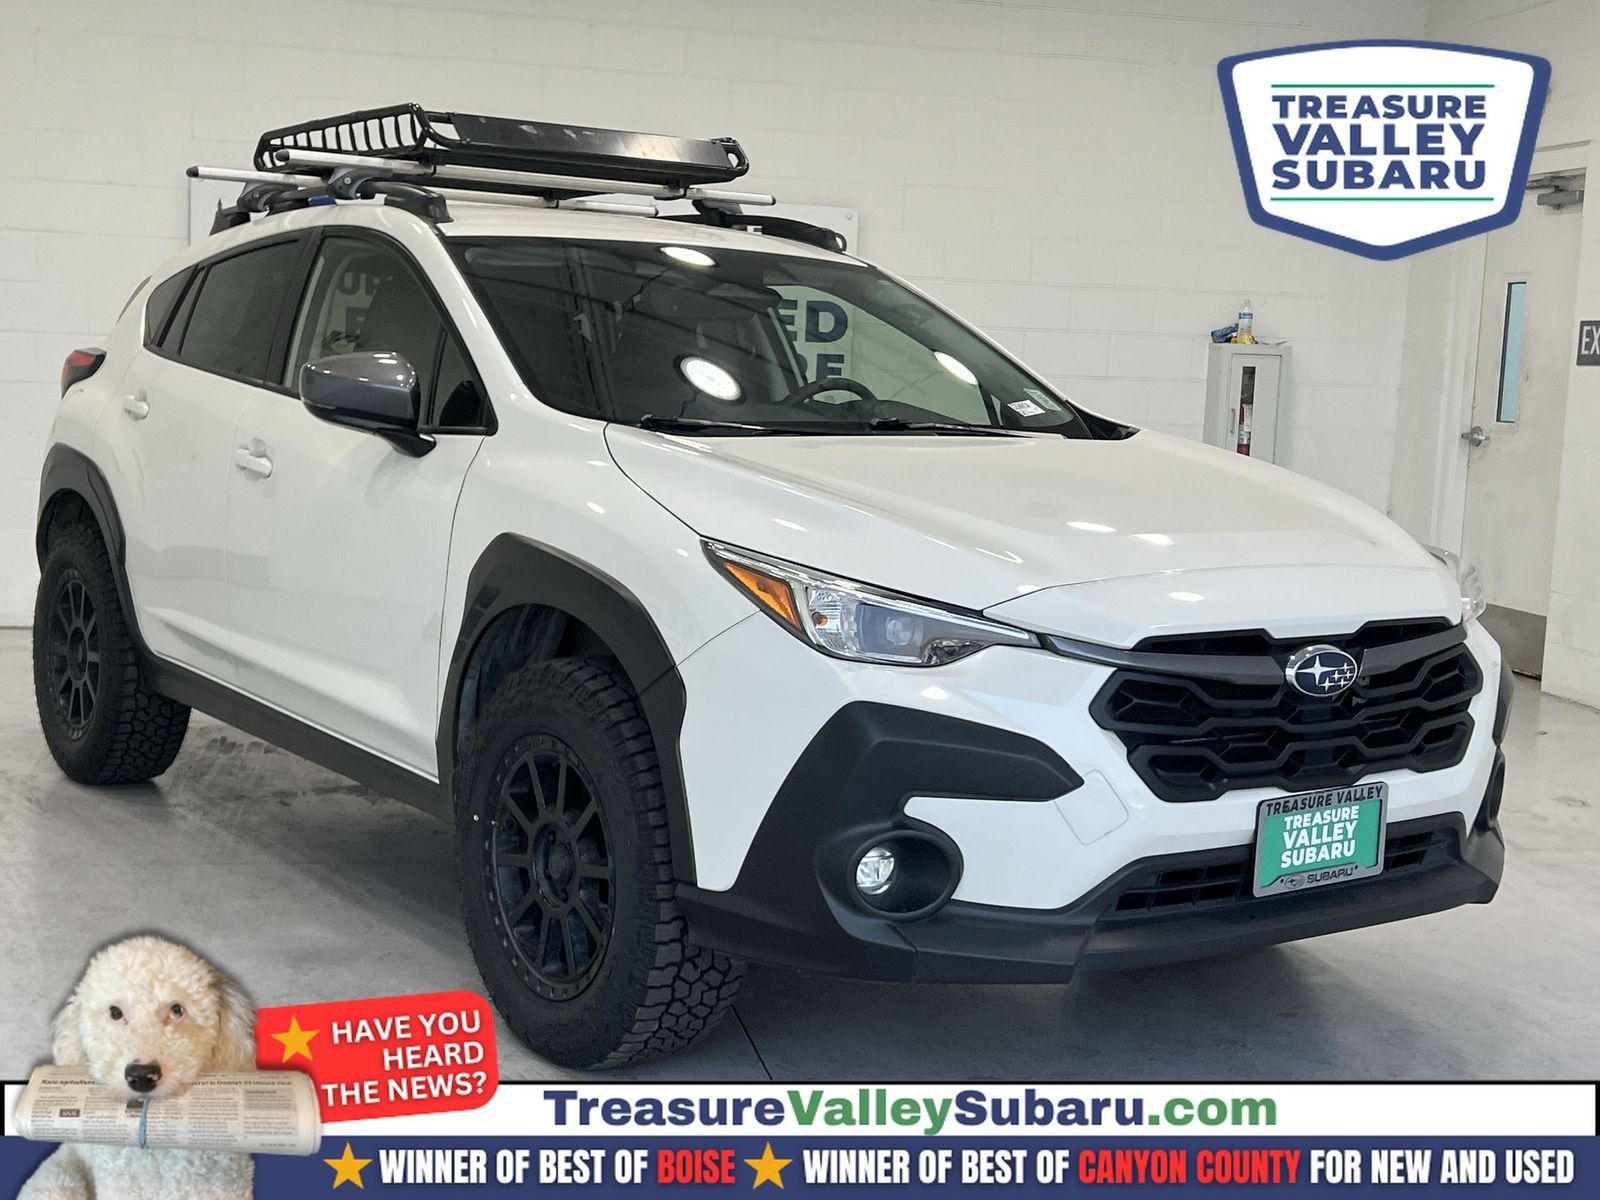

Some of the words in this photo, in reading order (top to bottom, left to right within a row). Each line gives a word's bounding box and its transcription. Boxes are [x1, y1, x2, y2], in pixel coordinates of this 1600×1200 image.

[1266, 792, 1333, 816] TREASURE
[1337, 785, 1383, 804] VALLEY
[1284, 805, 1360, 831] TREASURE
[1282, 820, 1358, 849] VALLEY
[1280, 840, 1356, 869] SUBARU
[1306, 867, 1354, 884] SUBARU
